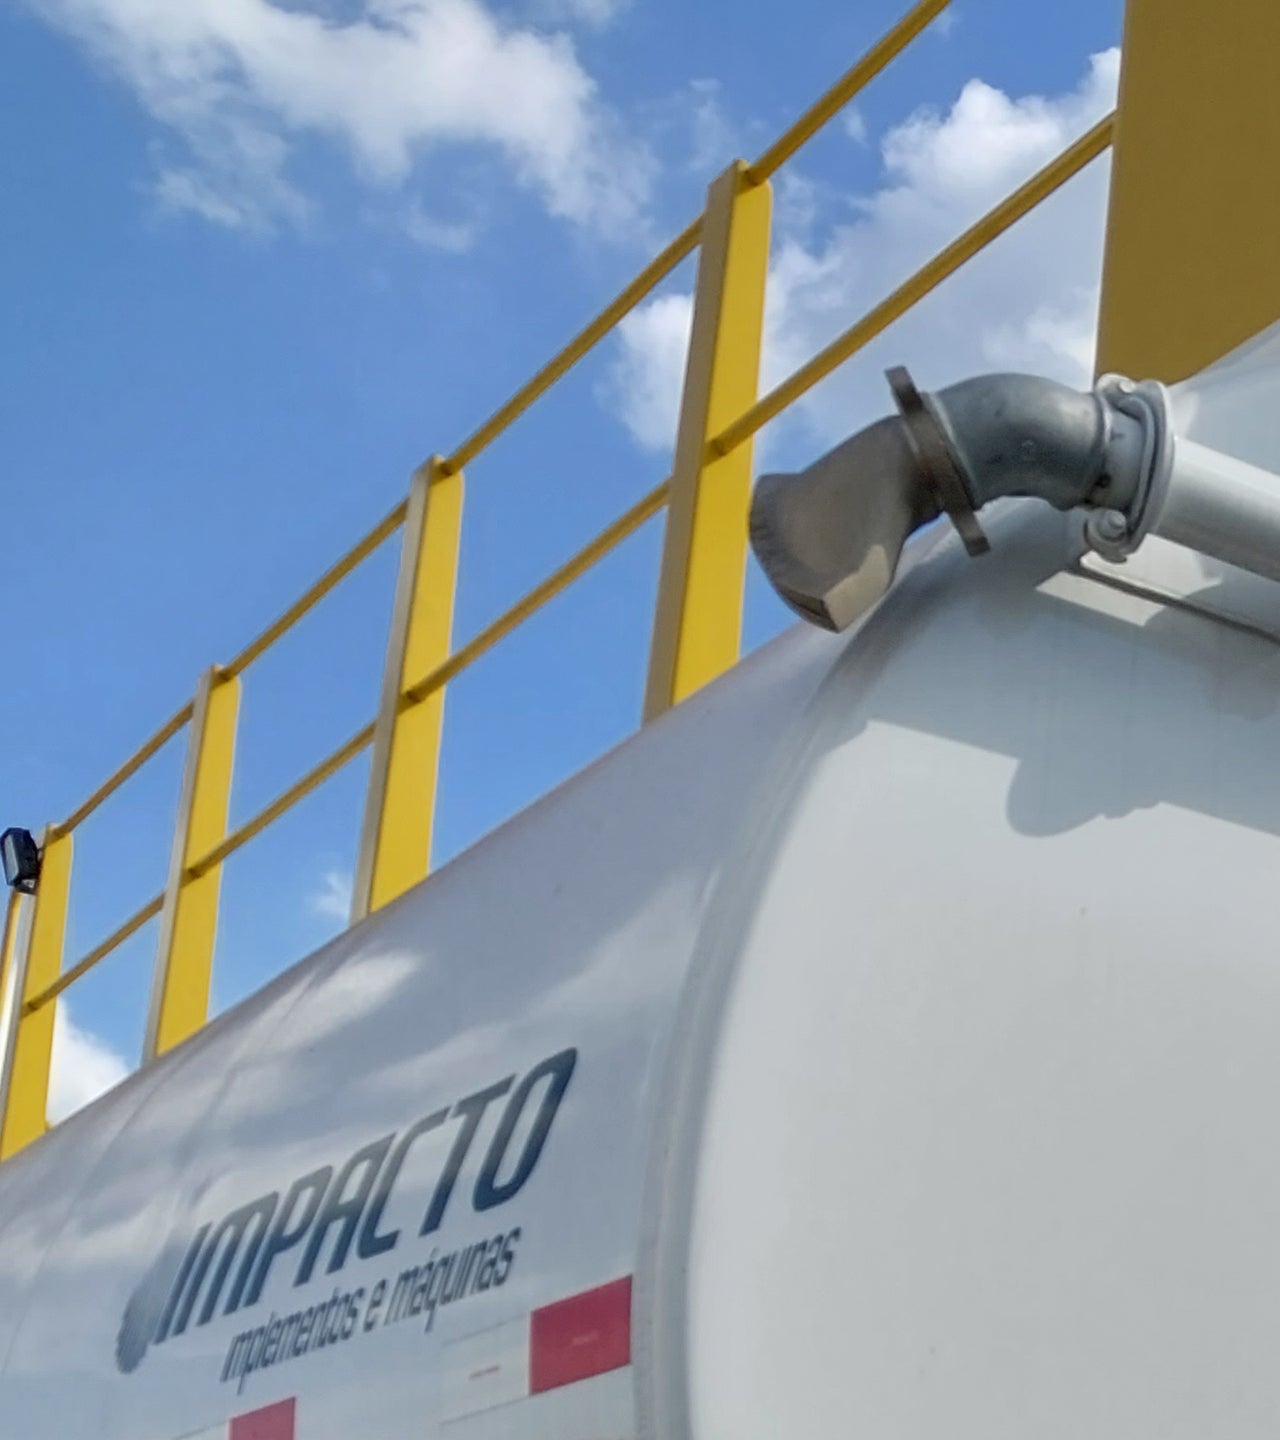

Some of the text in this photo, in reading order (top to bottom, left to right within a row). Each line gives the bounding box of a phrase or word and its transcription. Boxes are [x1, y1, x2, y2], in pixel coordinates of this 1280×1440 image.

[155, 1047, 578, 1346] IMPACTO
[220, 1226, 522, 1396] implementos e máquinas
